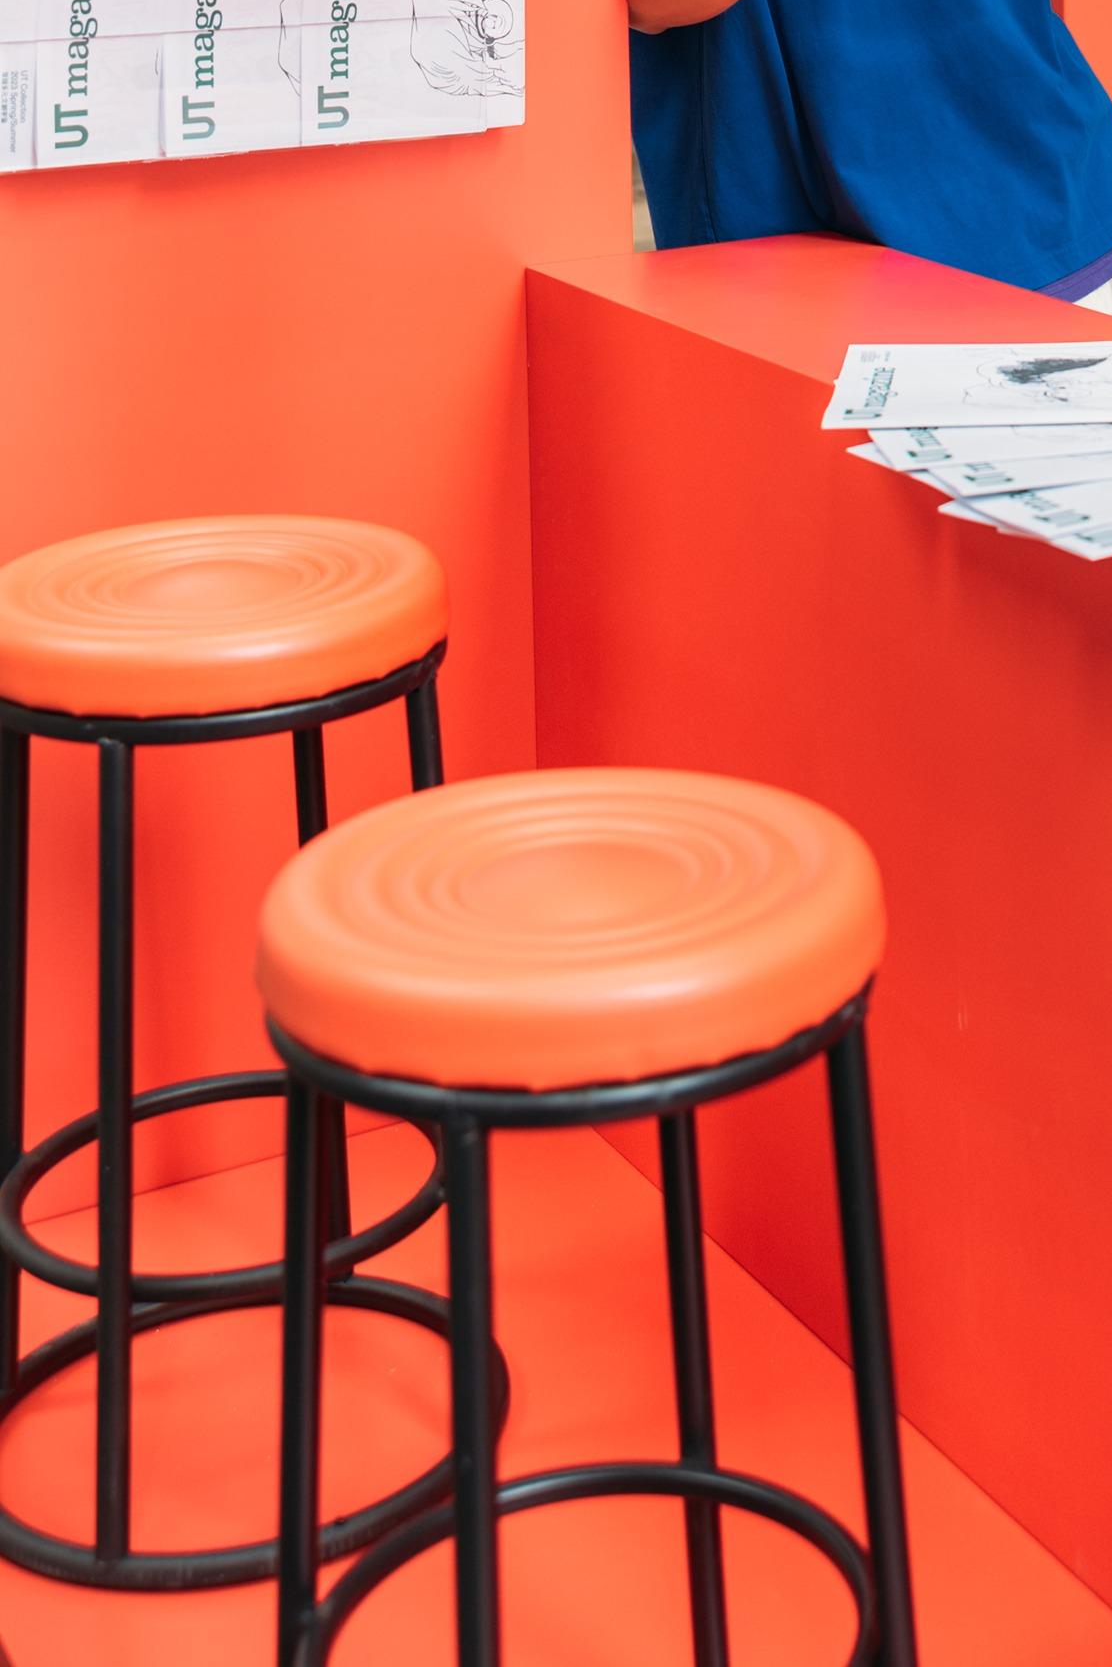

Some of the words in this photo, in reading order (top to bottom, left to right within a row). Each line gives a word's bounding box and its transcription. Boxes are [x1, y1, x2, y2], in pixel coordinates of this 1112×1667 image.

[55, 104, 89, 149] UT
[182, 95, 216, 140] UT
[317, 85, 350, 130] UT
